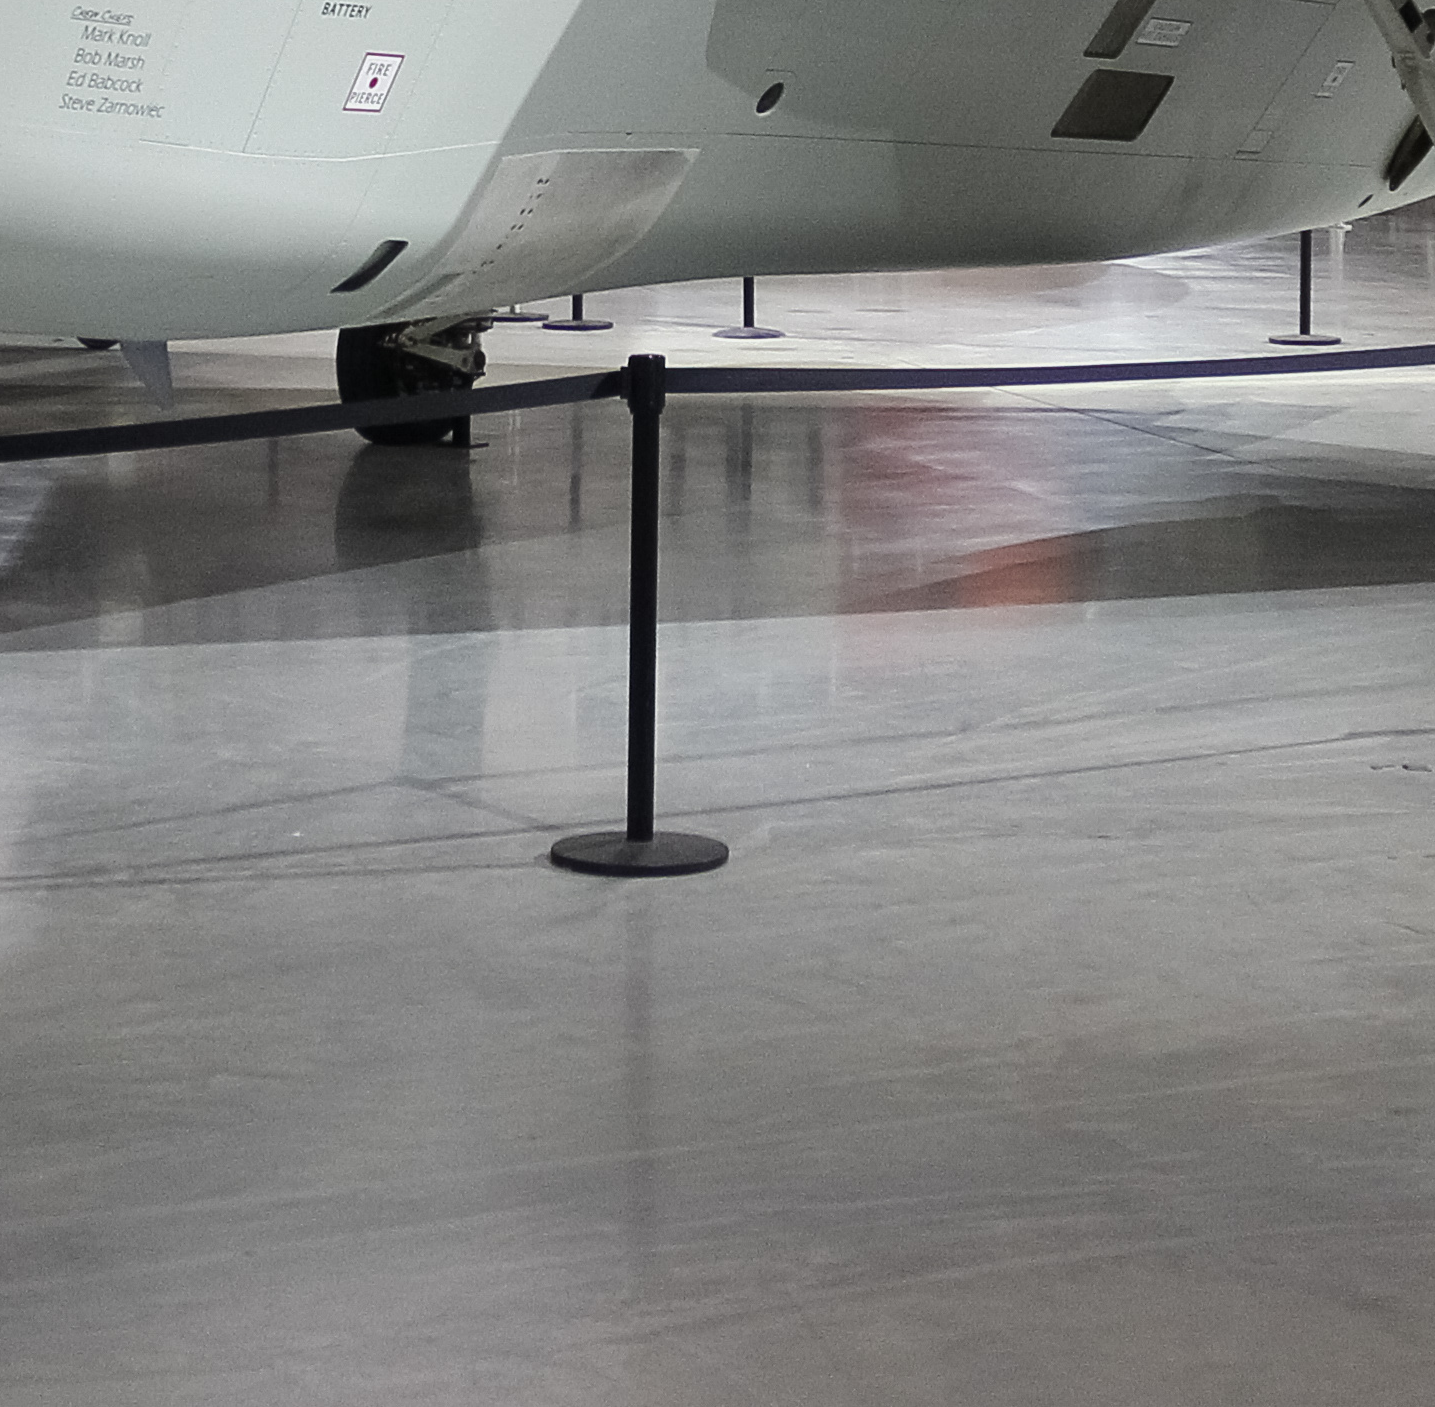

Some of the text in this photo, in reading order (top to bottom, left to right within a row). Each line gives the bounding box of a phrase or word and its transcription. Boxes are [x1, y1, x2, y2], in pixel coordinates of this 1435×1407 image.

[322, 2, 372, 19] BATTERY
[81, 25, 151, 47] Mark Knoll
[74, 48, 145, 70] Bob Marsh
[366, 62, 392, 76] FIRE
[66, 70, 143, 93] Ed Babcock
[59, 93, 96, 112] Steve
[349, 92, 384, 105] PIERCE
